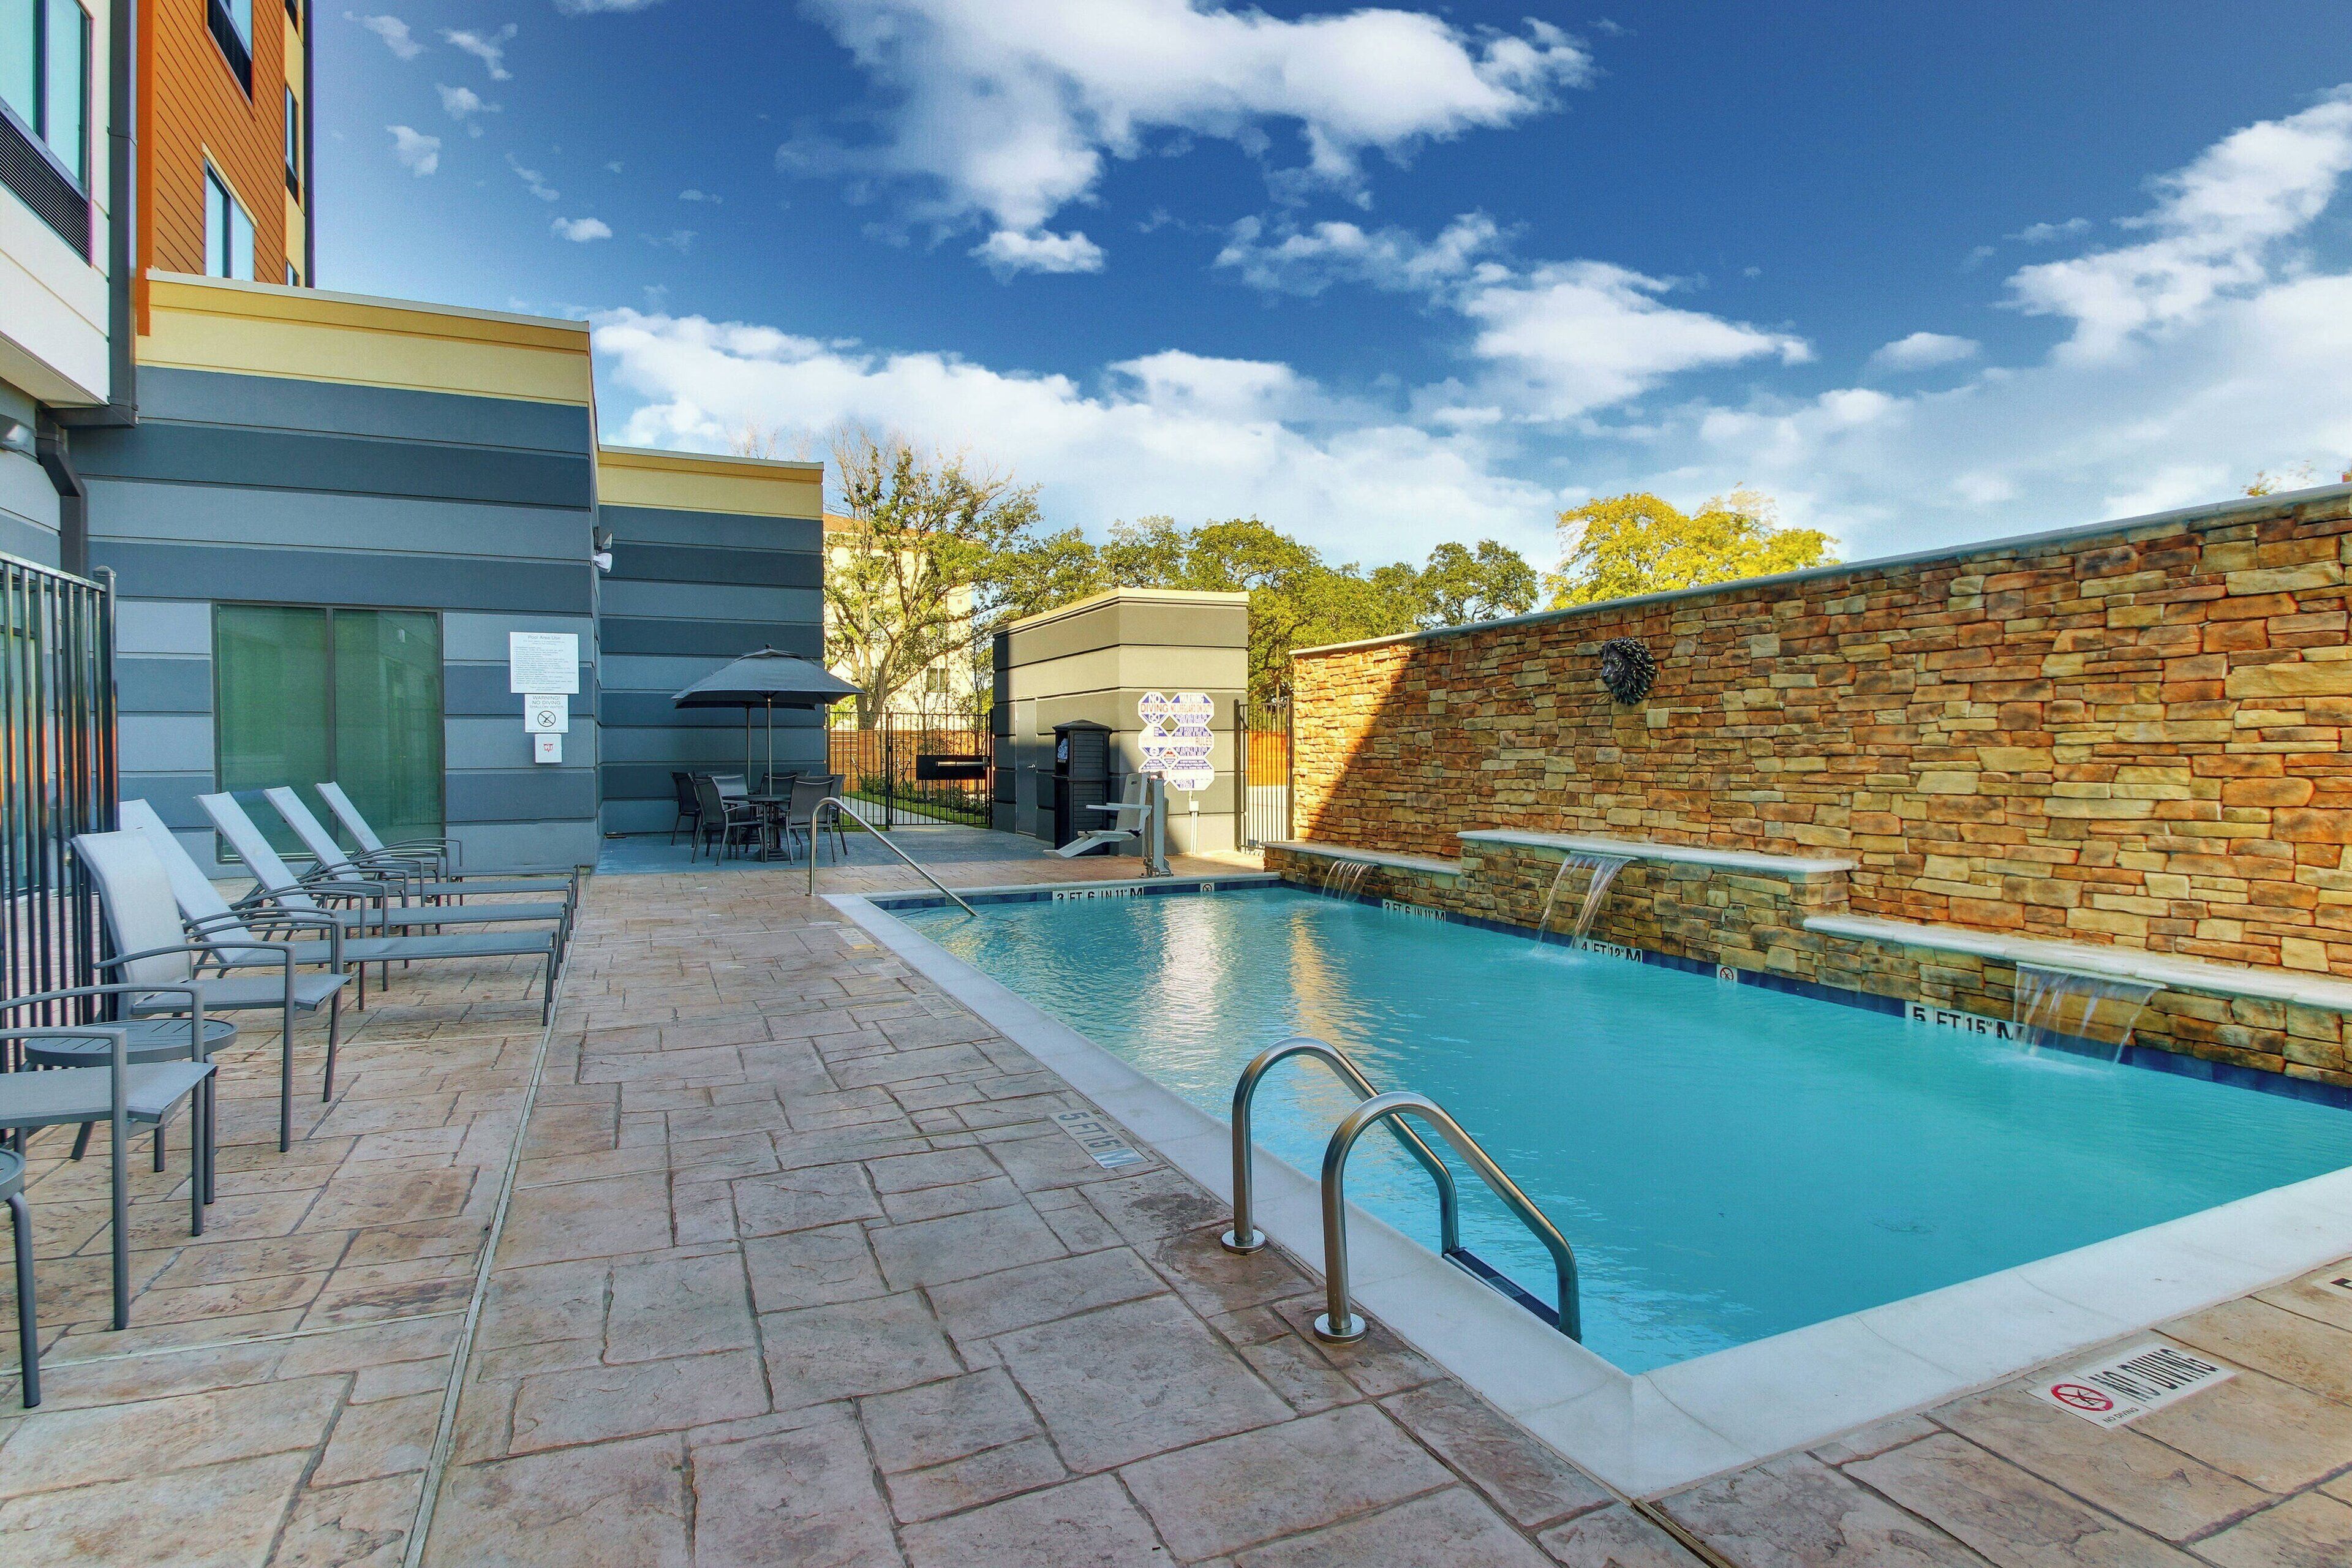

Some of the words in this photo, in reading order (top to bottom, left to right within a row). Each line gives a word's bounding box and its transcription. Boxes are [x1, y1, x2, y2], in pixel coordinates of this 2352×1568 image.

[1148, 694, 1161, 704] NO
[1140, 704, 1169, 712] DIVING
[1195, 737, 1212, 746] RULES
[1069, 892, 1082, 900] FT
[1130, 888, 1143, 896] M
[1435, 910, 1446, 921] M
[1594, 943, 1607, 954] FT
[1626, 948, 1642, 962] M
[1913, 1006, 1926, 1022] 5
[1937, 1011, 1961, 1028] FT
[1058, 1112, 1090, 1120] 5
[1068, 1122, 1108, 1134] FT
[1093, 1148, 1143, 1167] M
[2116, 1349, 2220, 1390] DIVING
[2088, 1371, 2162, 1402] NO
[2115, 1407, 2139, 1420] DIVING
